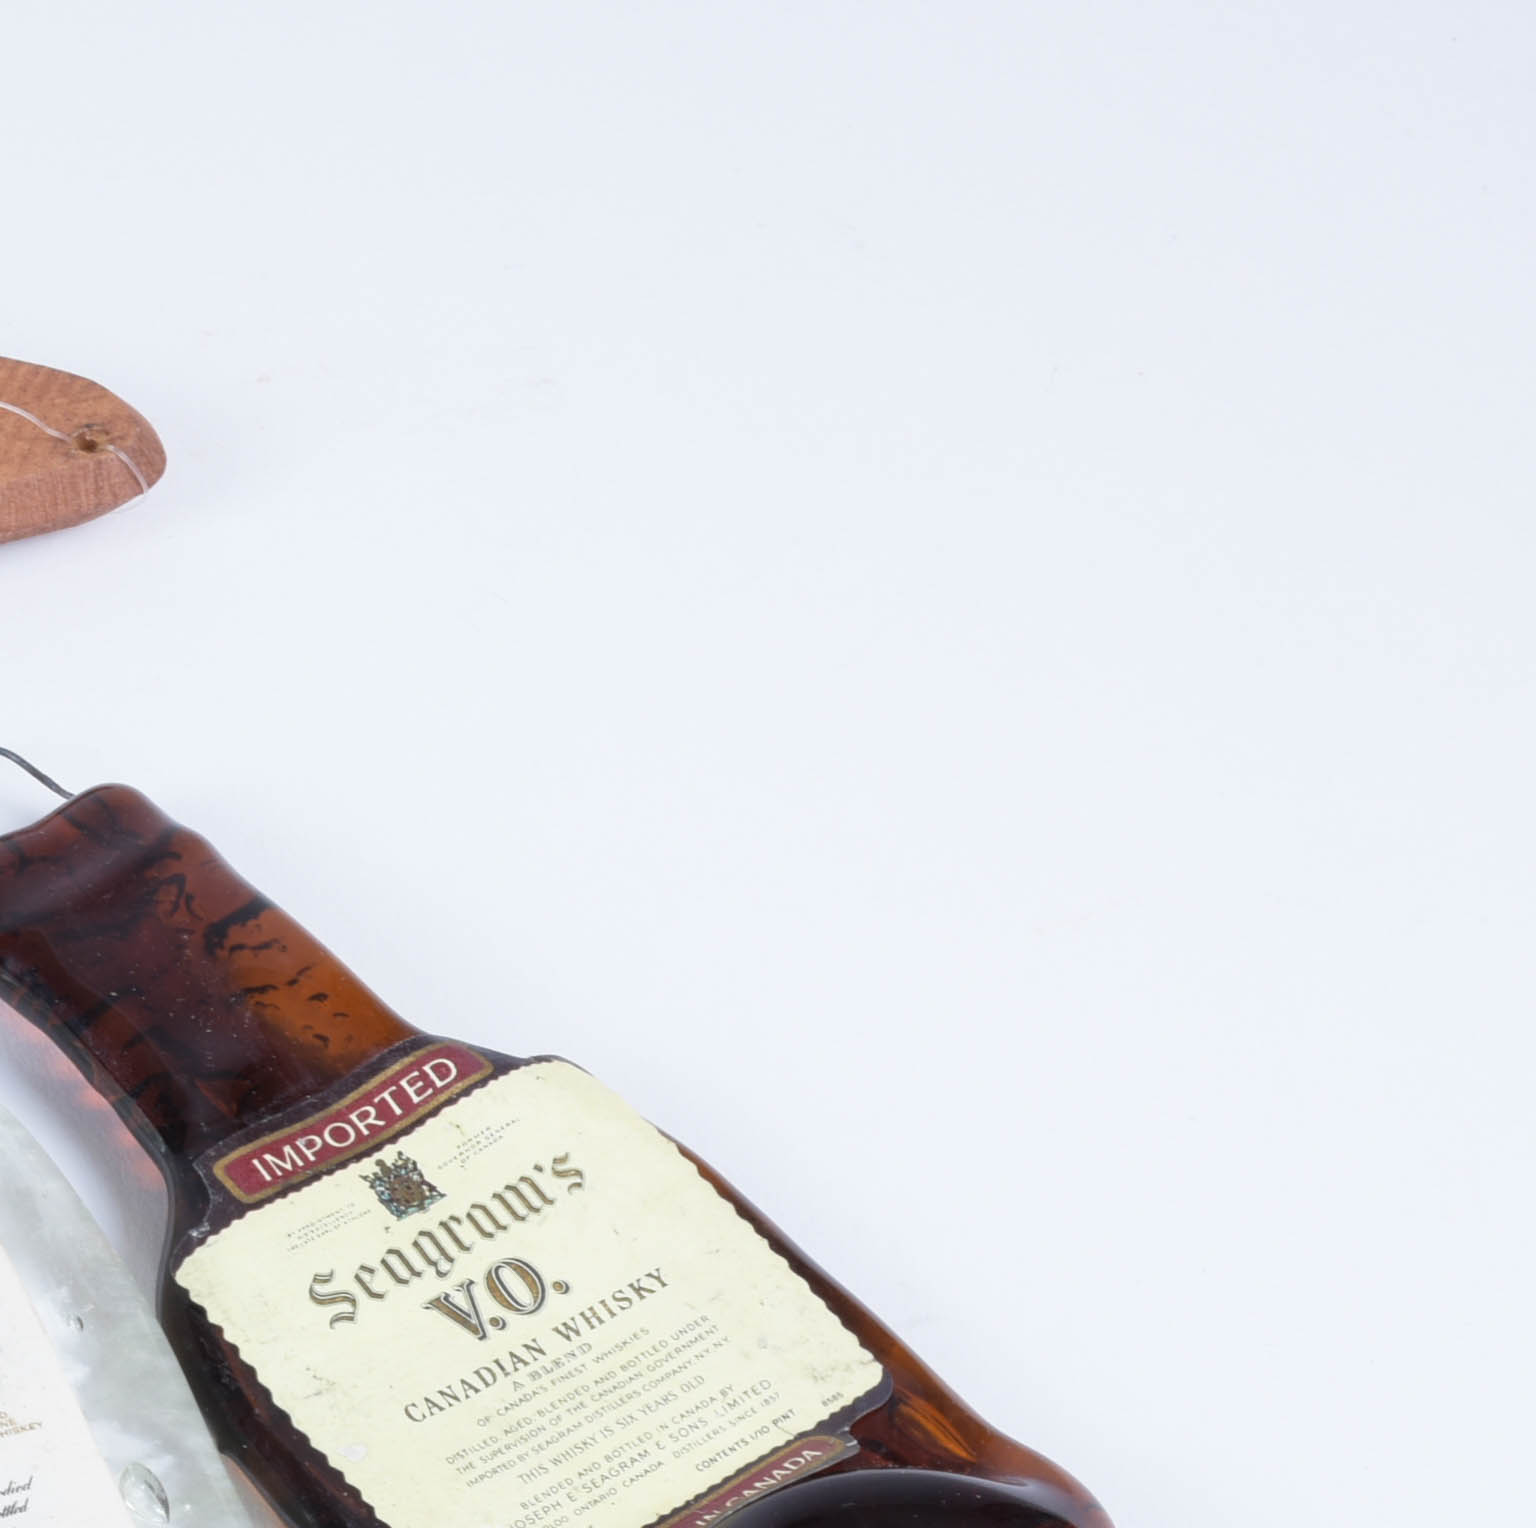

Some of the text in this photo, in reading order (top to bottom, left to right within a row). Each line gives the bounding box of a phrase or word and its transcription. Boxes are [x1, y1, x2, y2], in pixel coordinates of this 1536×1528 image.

[251, 1058, 458, 1182] IMPORTED
[308, 1152, 584, 1329] Seagram's
[422, 1257, 571, 1342] V.O.
[403, 1267, 669, 1423] CANADIAN WHISKY
[526, 1342, 593, 1382] BLEND
